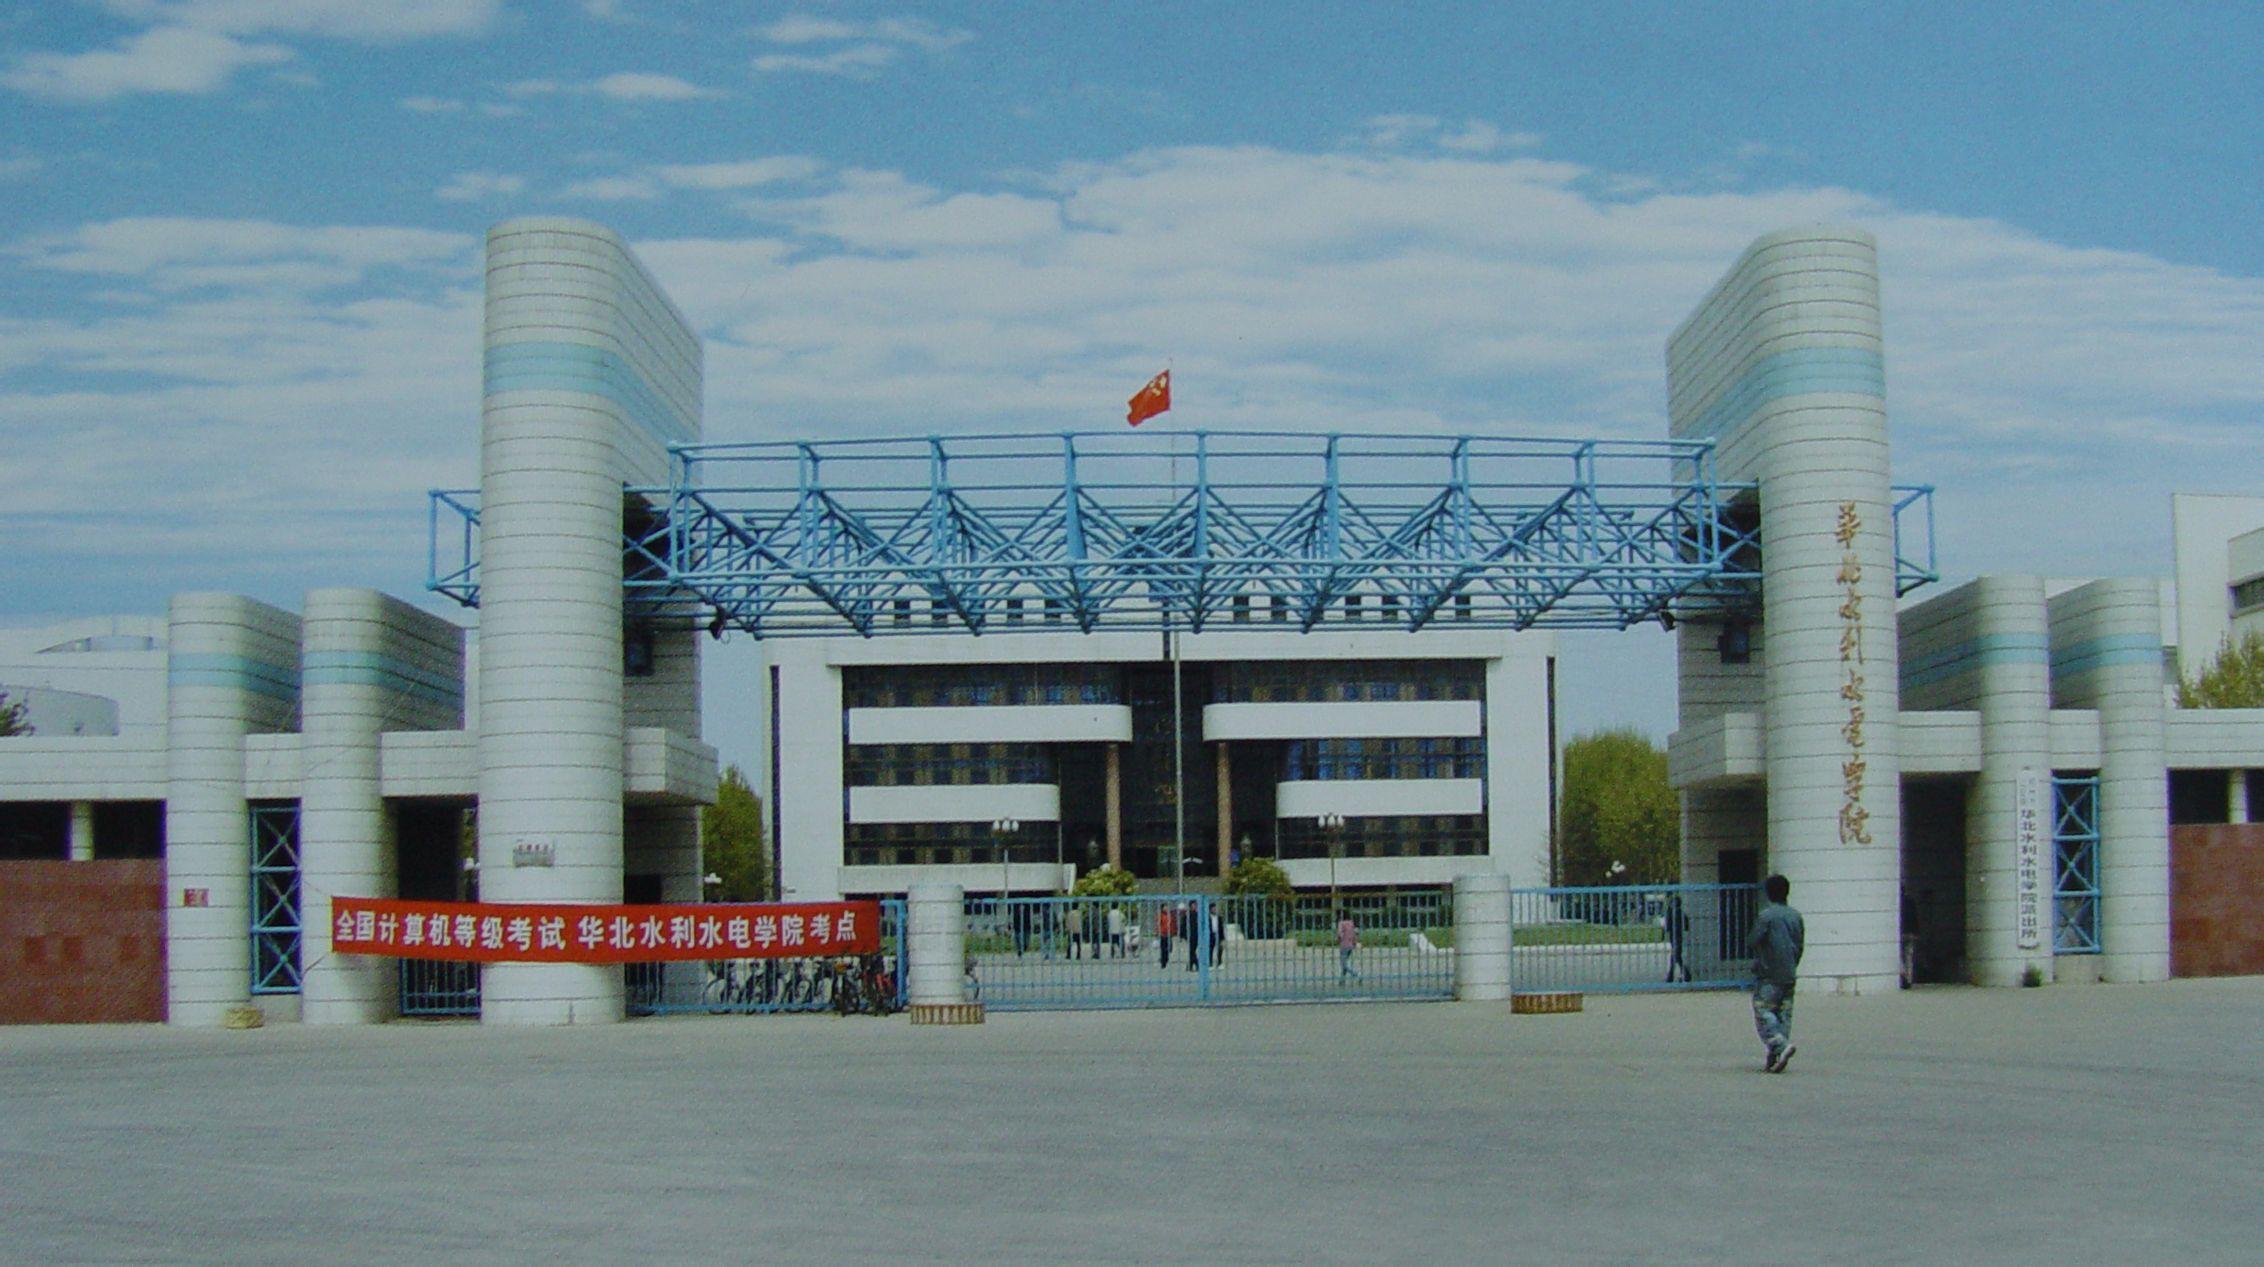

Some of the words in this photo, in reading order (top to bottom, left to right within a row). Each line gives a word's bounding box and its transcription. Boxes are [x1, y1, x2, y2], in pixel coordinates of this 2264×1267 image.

[336, 910, 566, 950] 全国计算机等级考试
[578, 910, 857, 950] 华北水利水电学院考点
